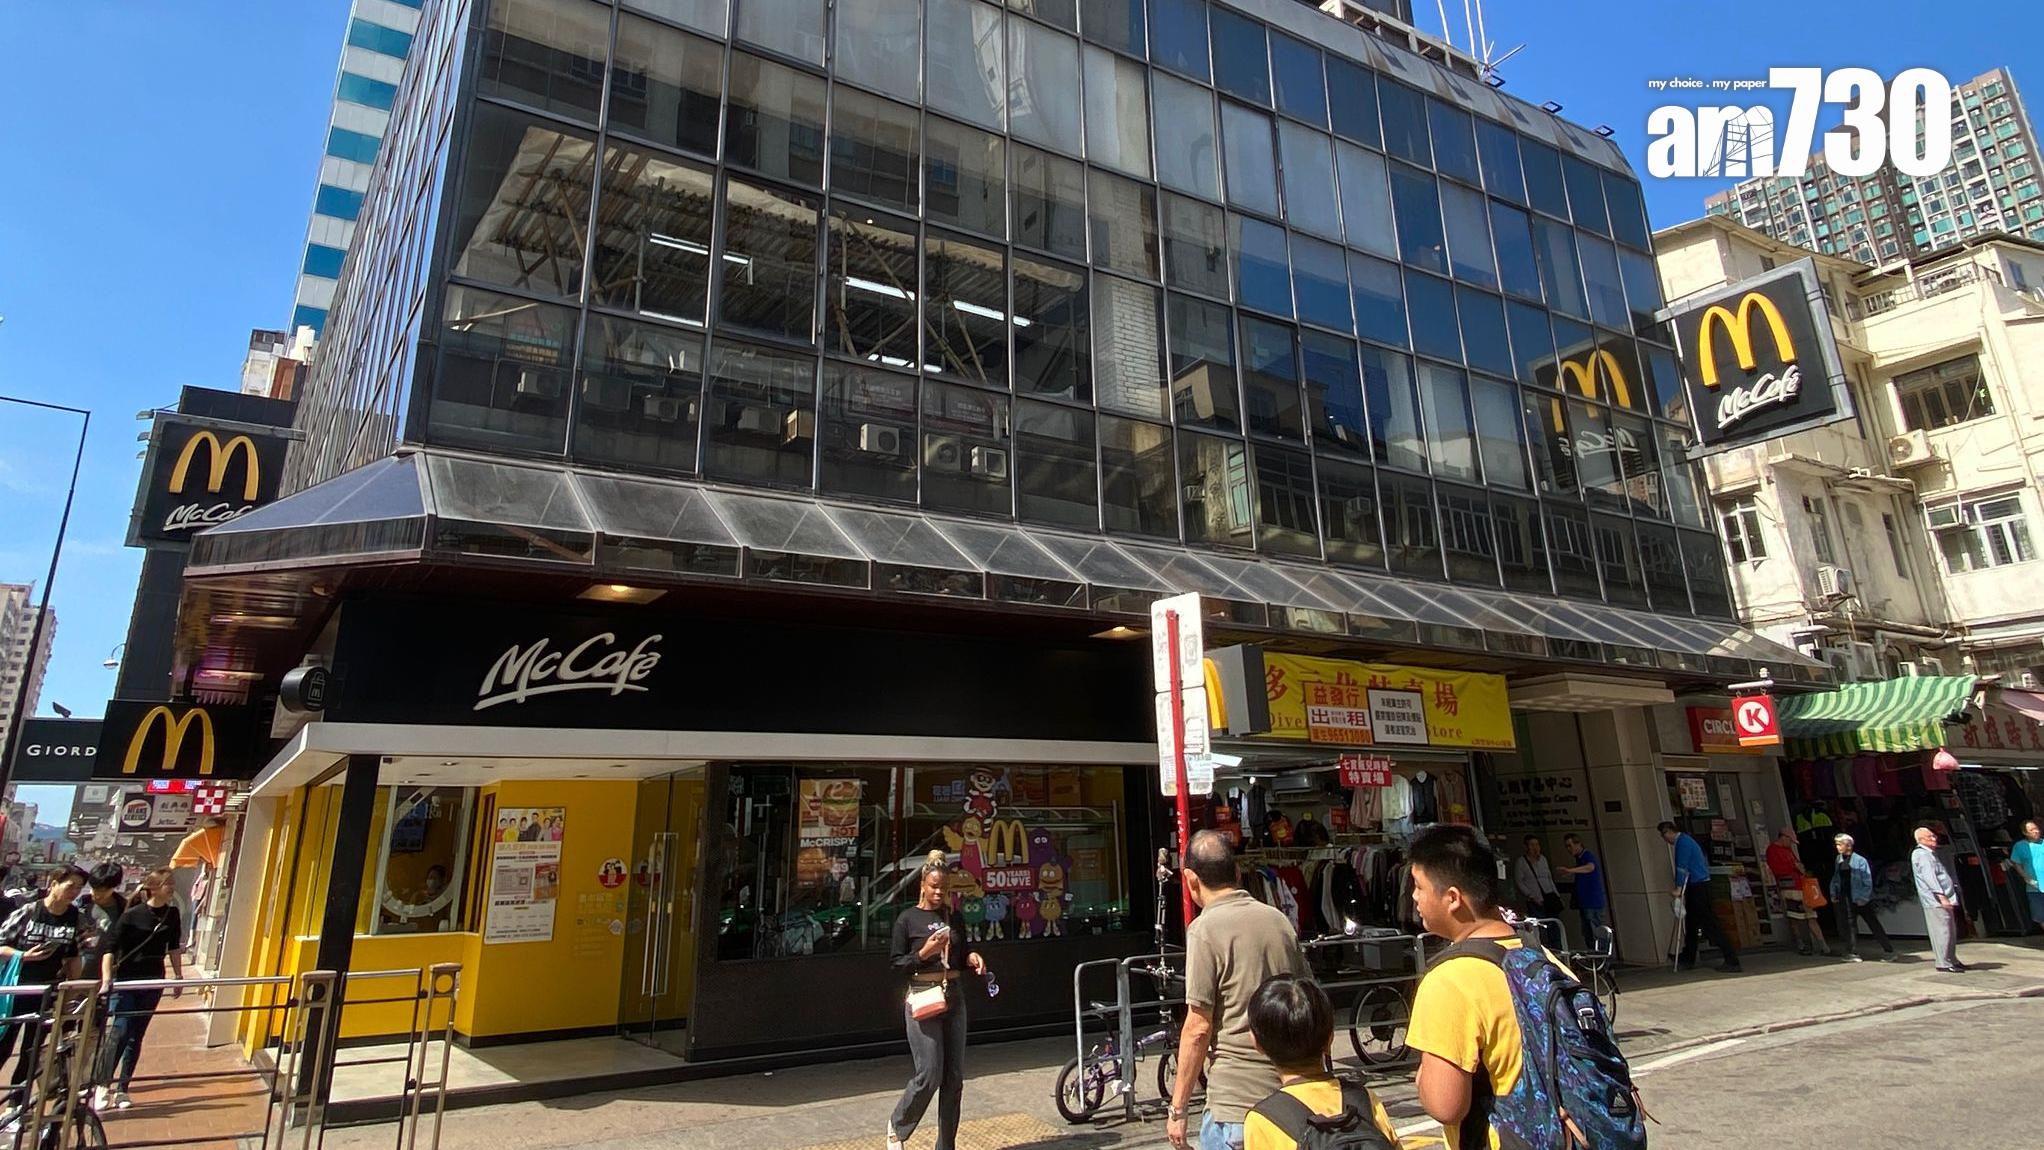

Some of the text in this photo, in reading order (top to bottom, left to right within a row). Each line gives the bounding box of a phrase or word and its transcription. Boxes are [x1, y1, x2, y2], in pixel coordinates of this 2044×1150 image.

[473, 632, 663, 710] McCafé
[26, 745, 97, 756] GIORD
[800, 837, 856, 848] McCRISPY
[986, 871, 1006, 888] 50
